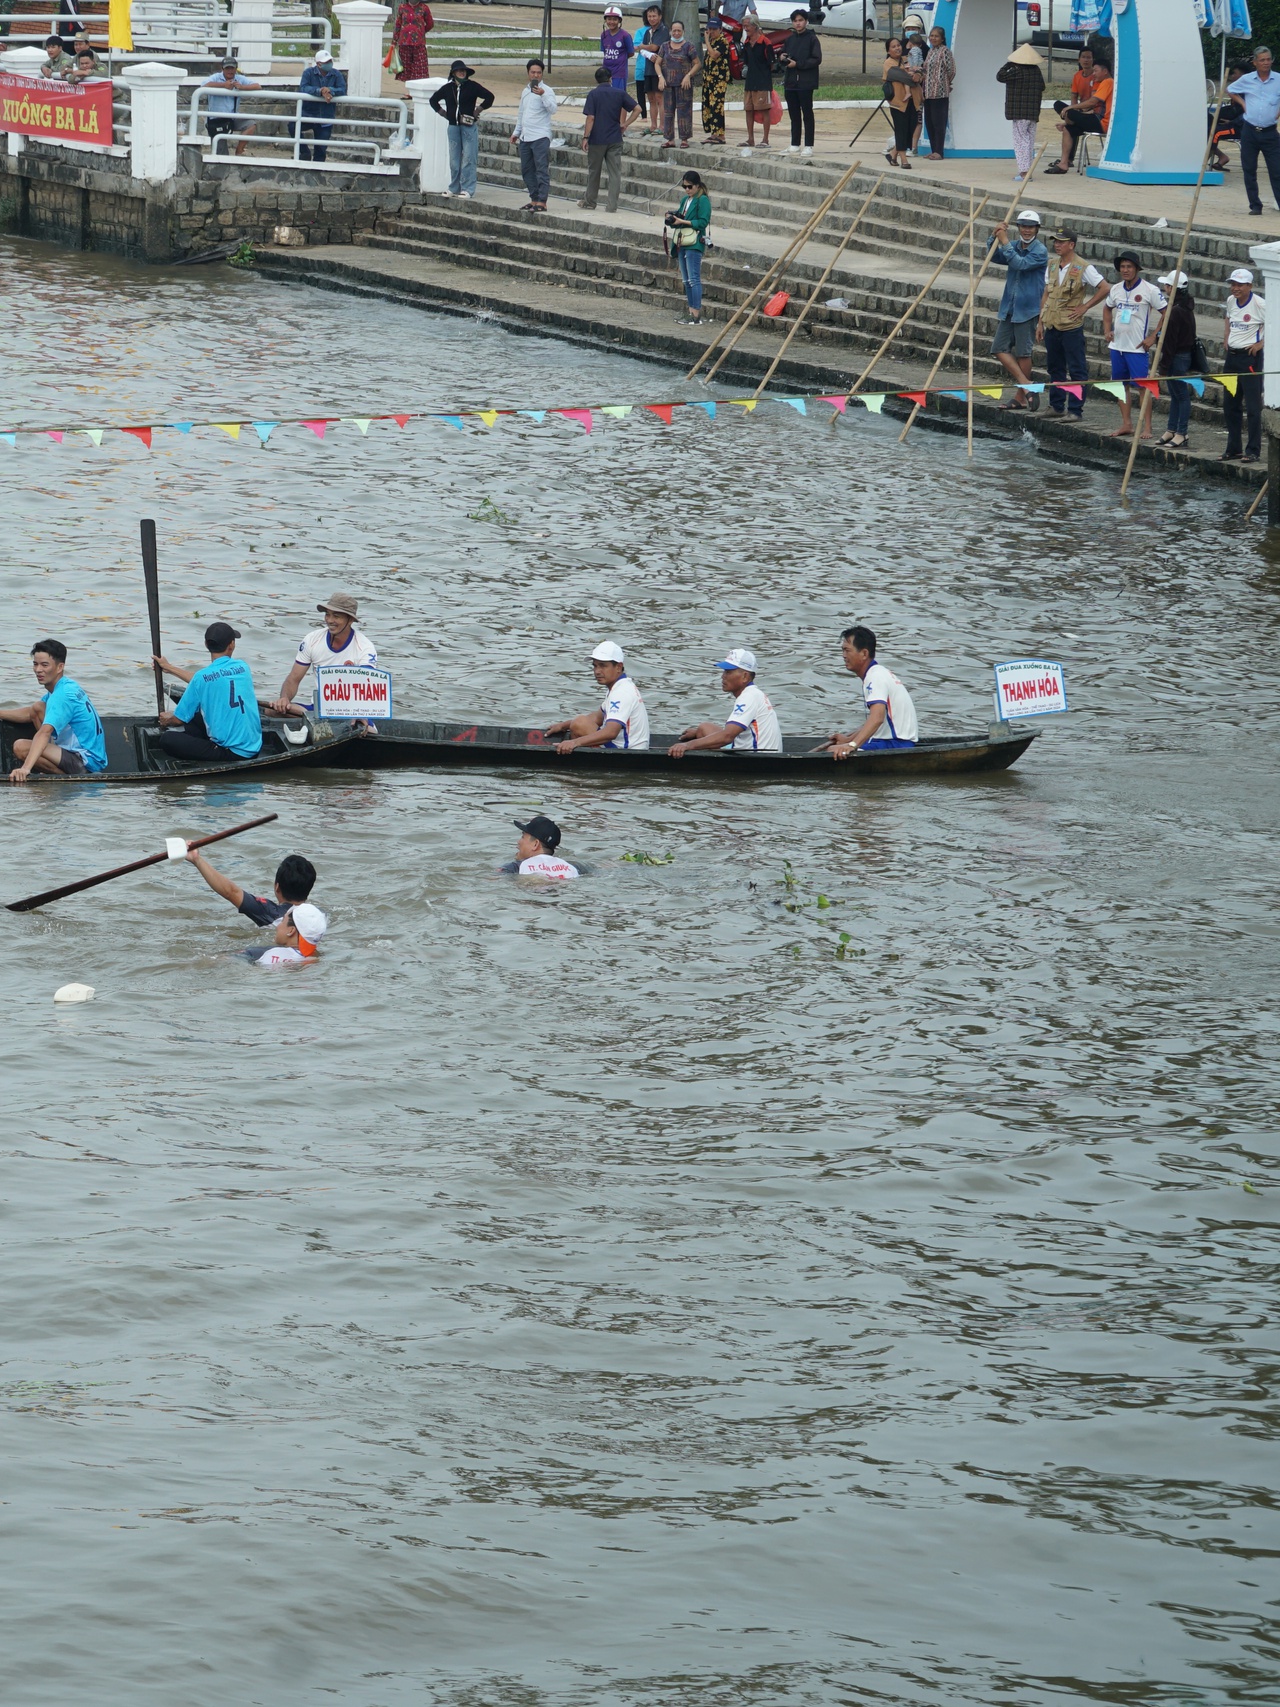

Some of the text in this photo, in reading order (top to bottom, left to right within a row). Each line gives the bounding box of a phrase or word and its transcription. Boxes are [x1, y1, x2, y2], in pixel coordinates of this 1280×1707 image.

[3, 93, 52, 128] XUỒNG
[55, 106, 76, 131] BA
[79, 104, 99, 134] LÁ
[230, 680, 245, 714] 4
[324, 678, 386, 701] CHÂU THÀNH
[1002, 672, 1060, 705] THẠNH HÓA
